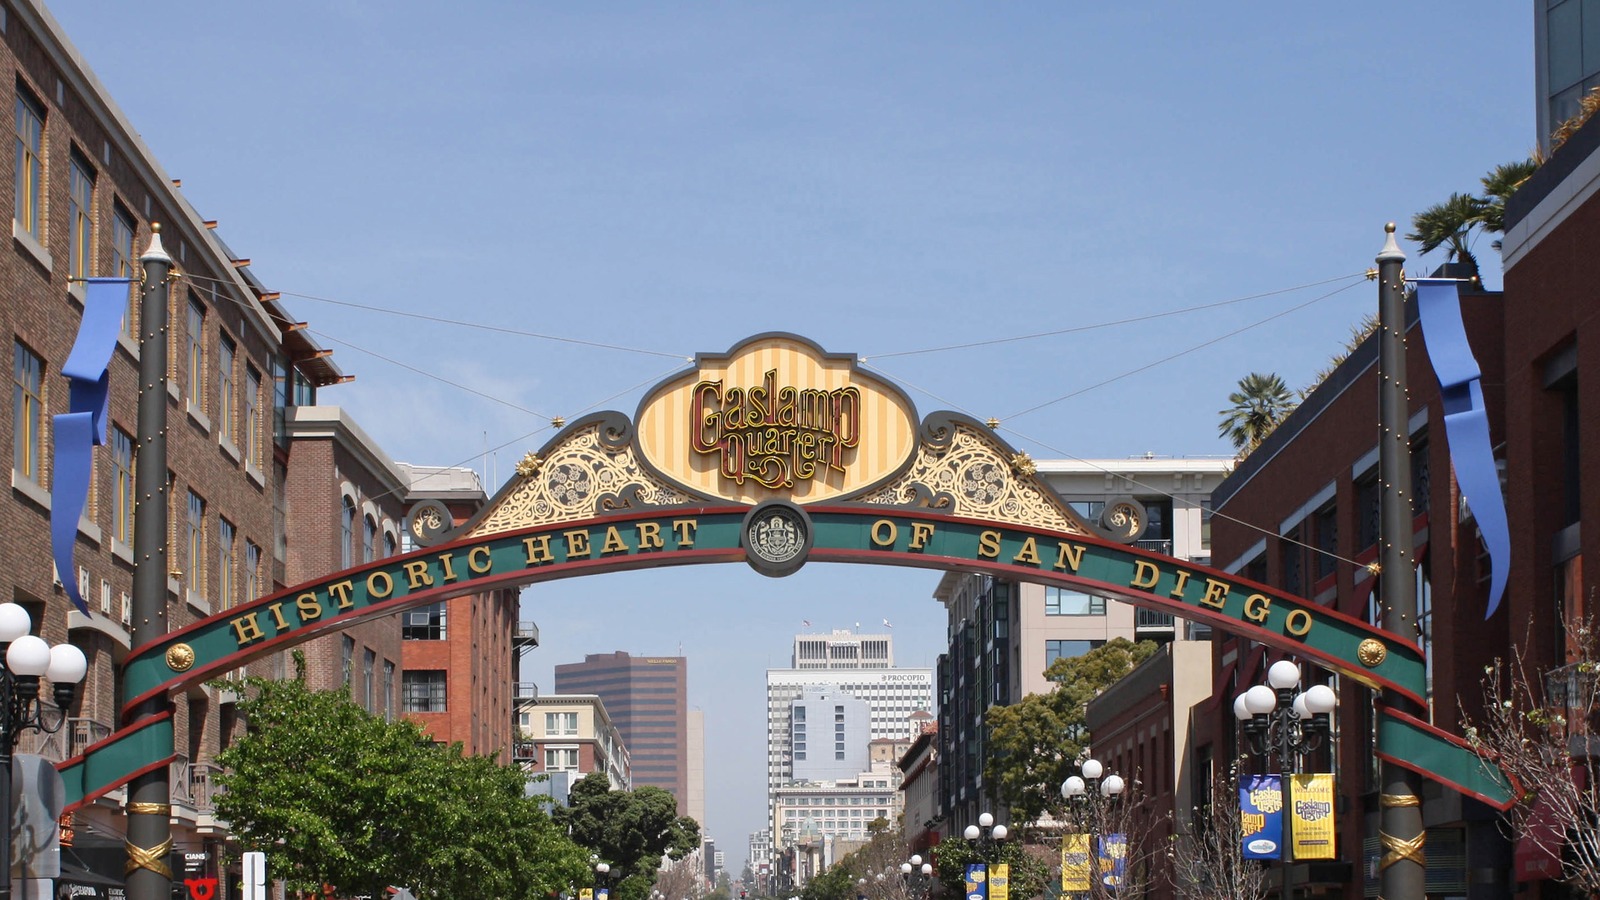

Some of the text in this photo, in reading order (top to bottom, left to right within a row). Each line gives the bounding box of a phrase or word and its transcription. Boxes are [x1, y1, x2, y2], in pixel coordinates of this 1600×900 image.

[692, 368, 861, 472] Gaslamp
[721, 427, 834, 489] Quarter
[229, 545, 492, 645] HISTORIC
[522, 519, 698, 564] HEART
[870, 519, 934, 550] OF
[978, 530, 1086, 571] SAN
[1130, 559, 1313, 636] DIEGO
[1296, 799, 1330, 817] Gaslamp
